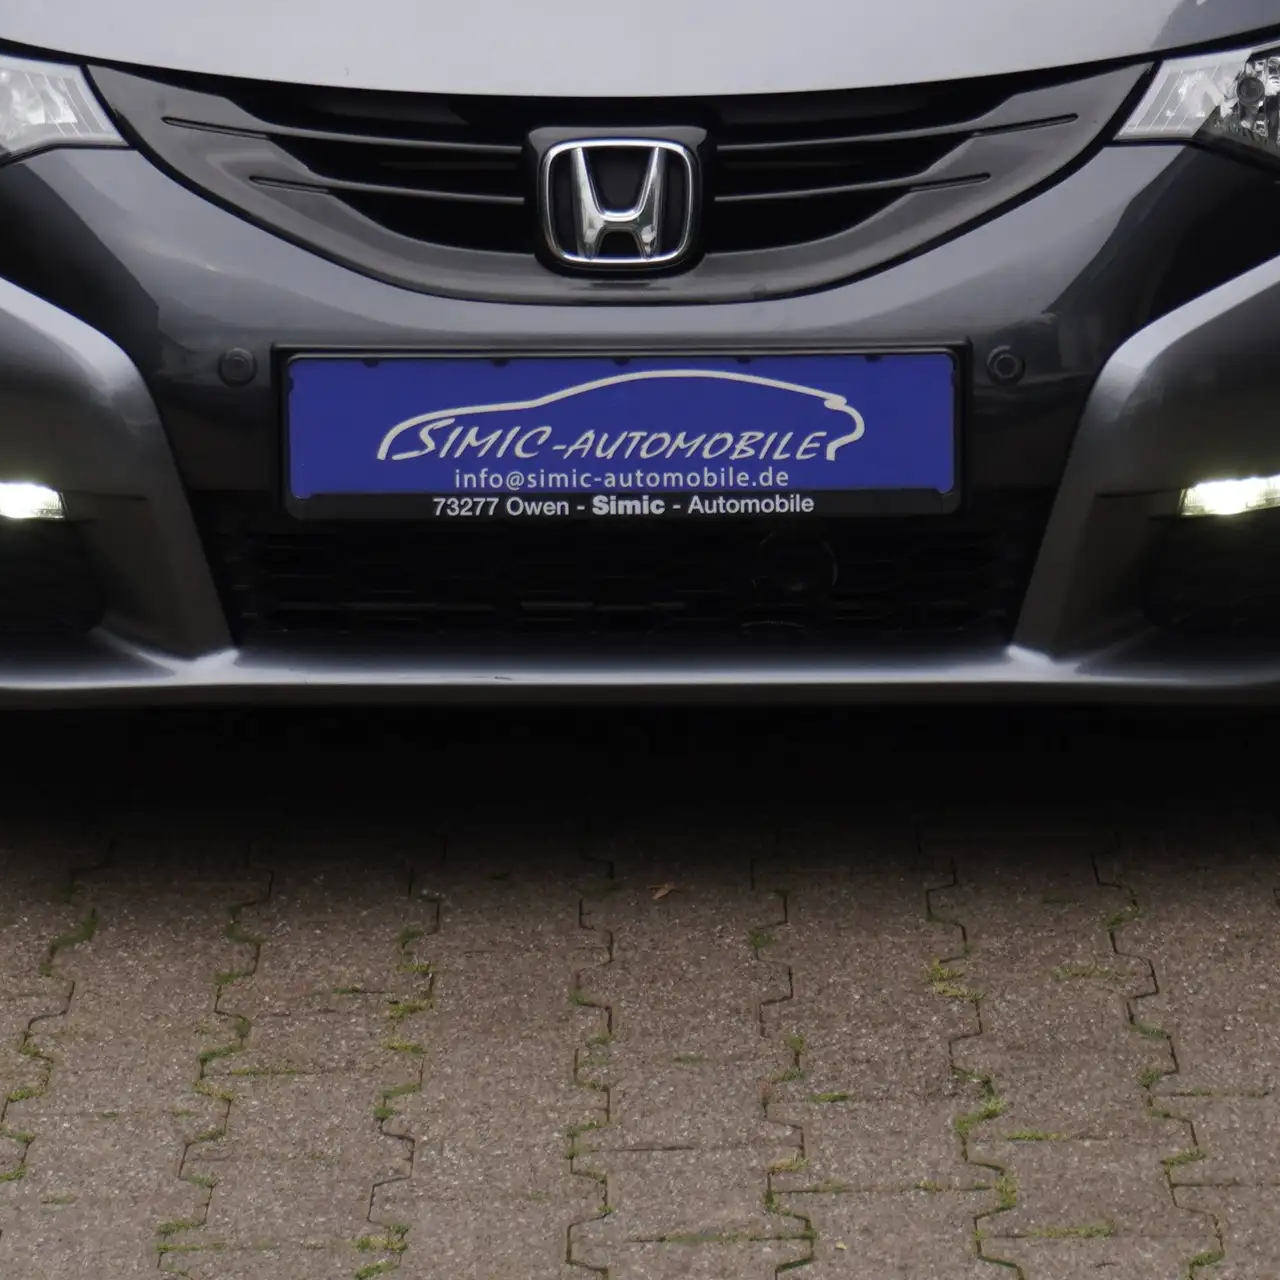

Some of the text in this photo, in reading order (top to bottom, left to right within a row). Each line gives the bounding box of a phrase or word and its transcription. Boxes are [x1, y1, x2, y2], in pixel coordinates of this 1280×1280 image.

[455, 466, 789, 490] info@simic-automobile.de
[433, 497, 499, 516] 73277
[506, 496, 569, 516] Owen
[592, 495, 666, 516] Simic
[687, 493, 815, 514] Automobile
